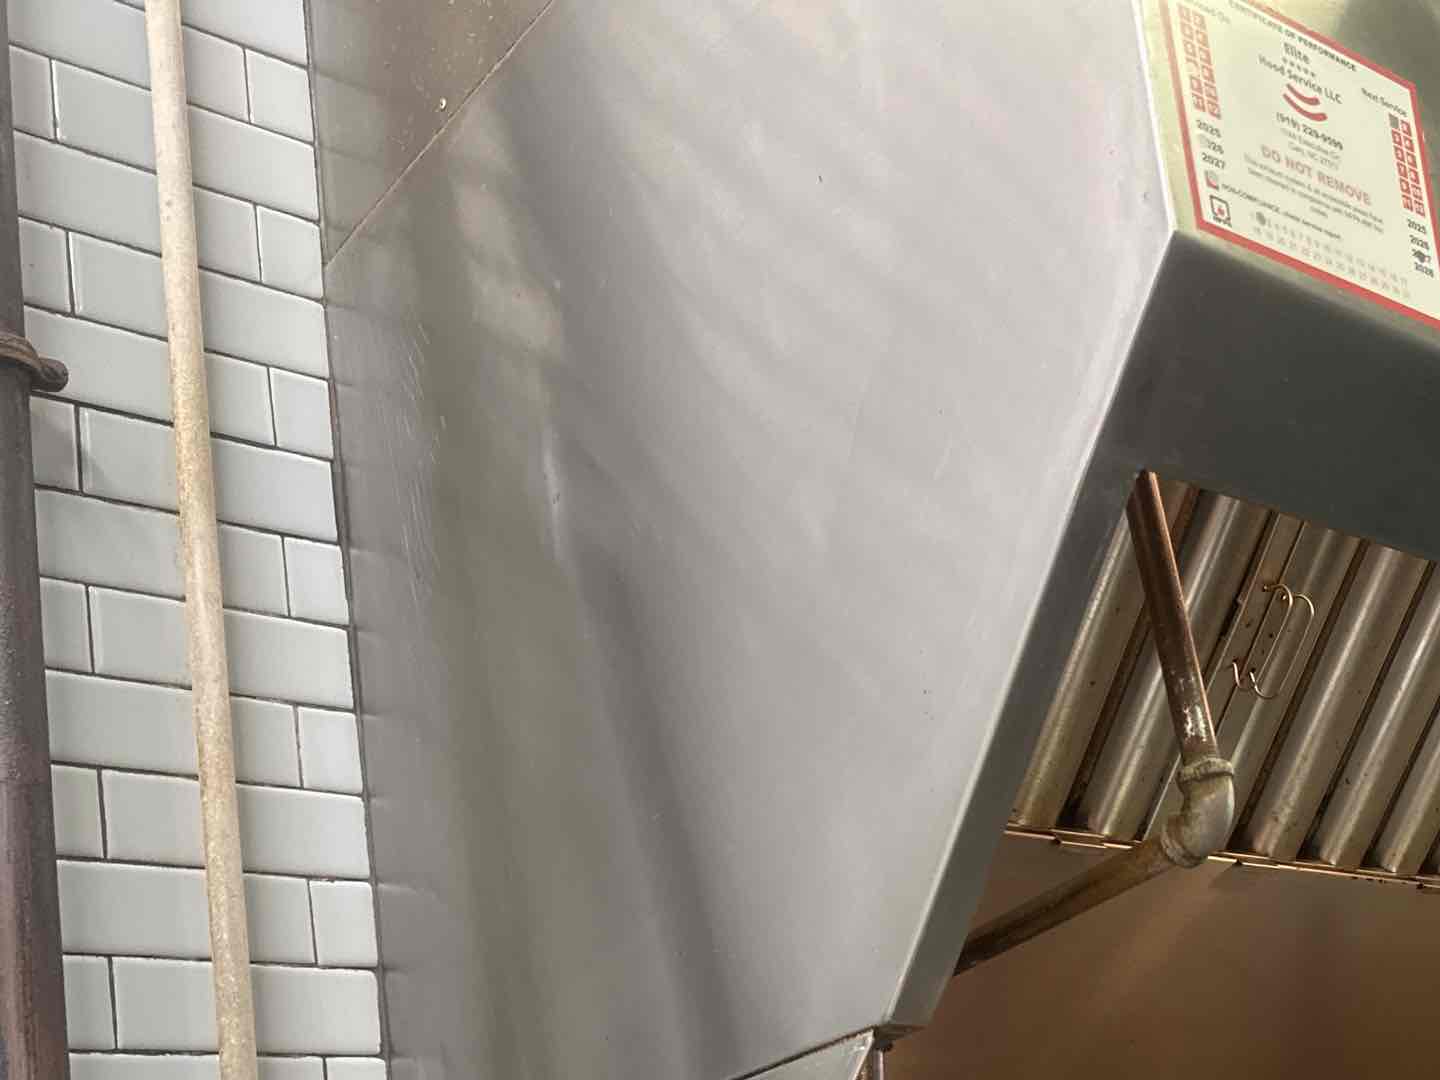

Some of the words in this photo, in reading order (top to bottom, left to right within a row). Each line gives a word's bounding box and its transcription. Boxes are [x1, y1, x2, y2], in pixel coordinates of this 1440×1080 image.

[1284, 42, 1310, 64] Elite
[1297, 36, 1356, 72] PERFORMANCE
[1259, 53, 1286, 76] Hood
[1287, 69, 1322, 94] Service
[1324, 88, 1343, 104] LLC
[1261, 144, 1281, 163] DO
[1284, 154, 1312, 177] NOT
[1317, 170, 1372, 206] REMOVE
